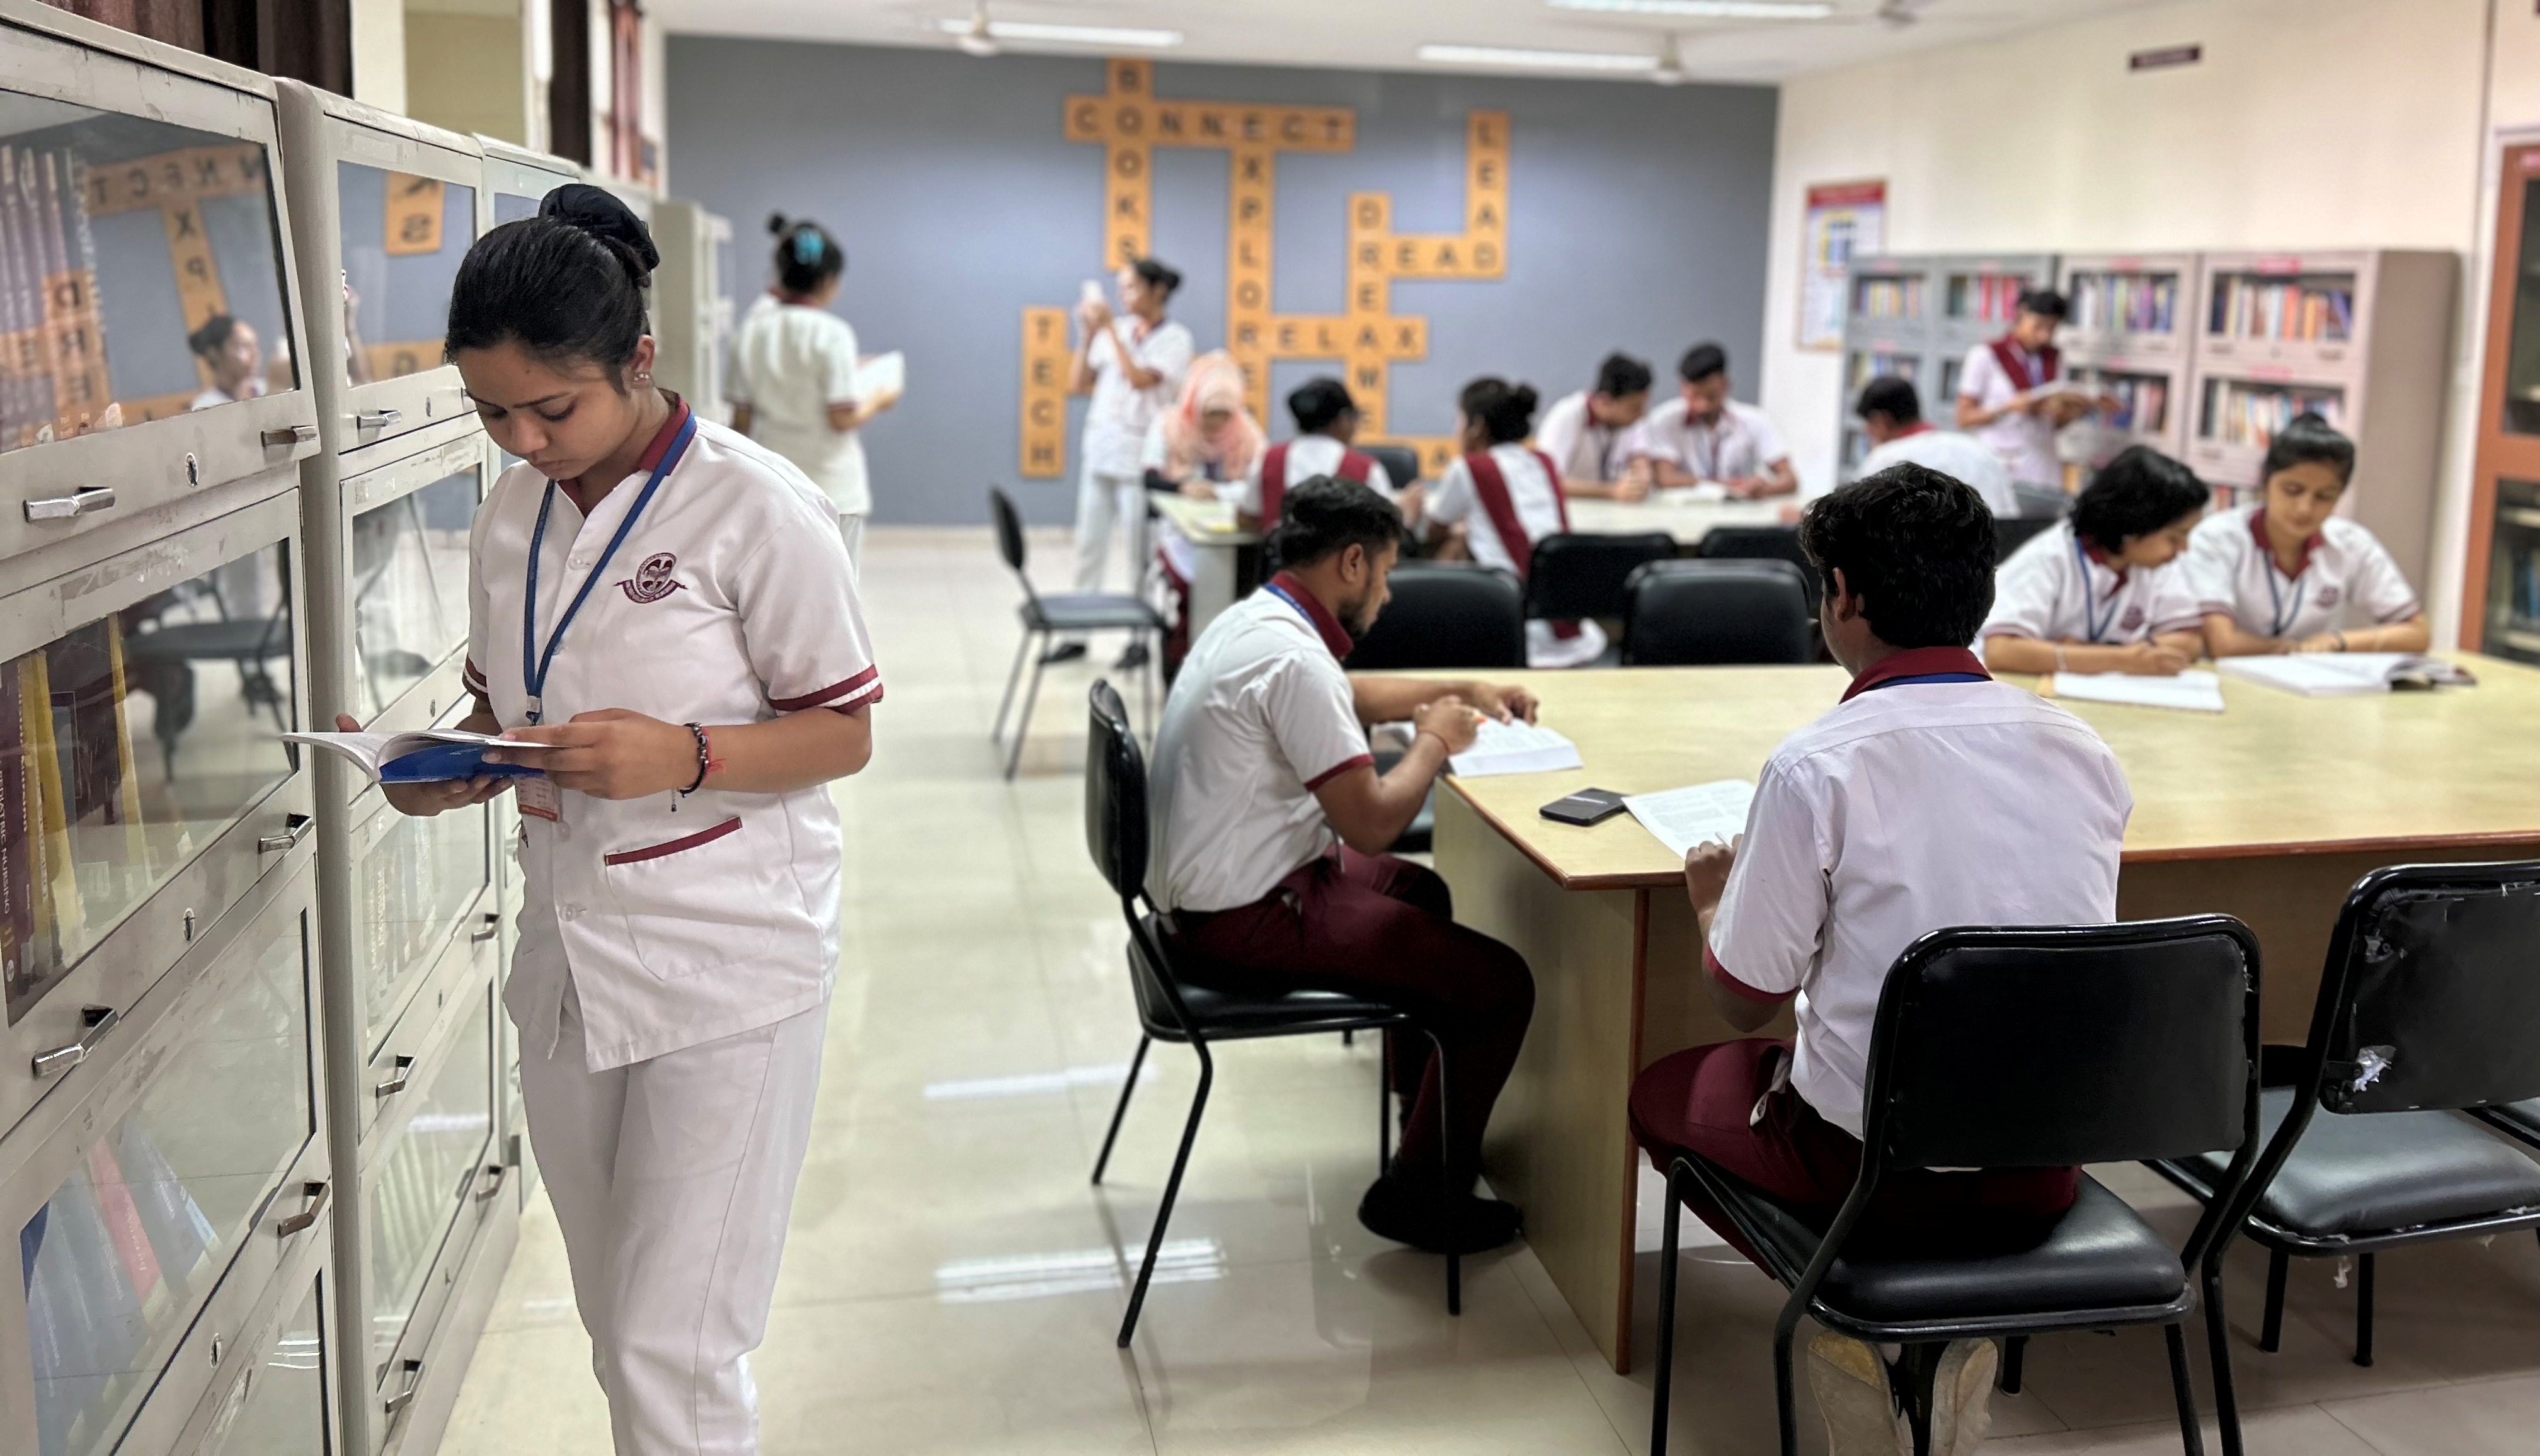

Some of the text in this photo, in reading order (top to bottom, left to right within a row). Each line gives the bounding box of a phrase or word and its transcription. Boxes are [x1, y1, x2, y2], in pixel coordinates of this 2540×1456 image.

[1074, 103, 1343, 140] CONNECT
[1114, 67, 1143, 261] BOOKS
[1474, 121, 1499, 268] LEAD
[1358, 241, 1497, 269] READ
[1237, 321, 1416, 352] RELAX
[1031, 316, 1056, 465] TECH
